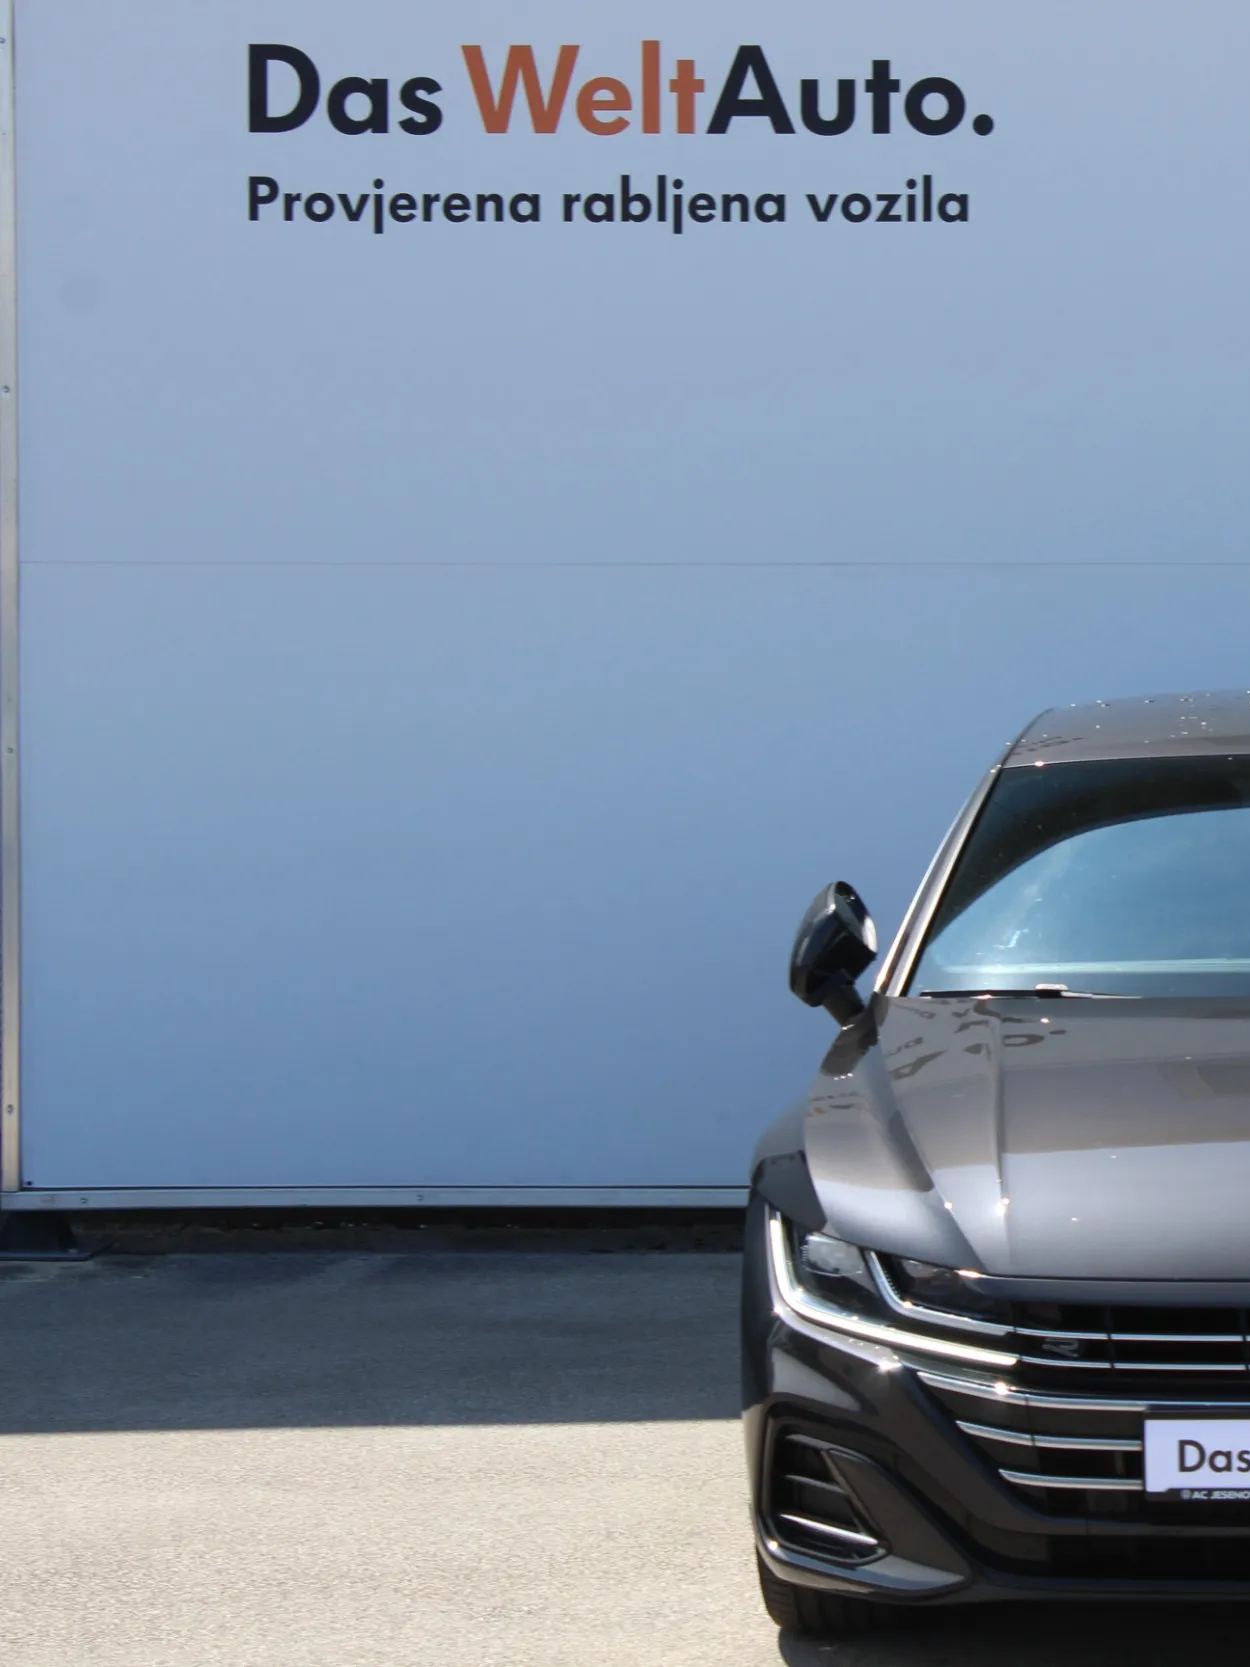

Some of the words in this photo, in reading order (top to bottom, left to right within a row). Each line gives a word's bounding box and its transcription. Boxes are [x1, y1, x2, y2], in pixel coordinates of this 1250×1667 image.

[249, 43, 443, 136] Das
[461, 40, 995, 137] WeltAuto.
[248, 175, 541, 235] Provjerena
[563, 174, 786, 235] rabljena
[805, 174, 969, 223] vozila
